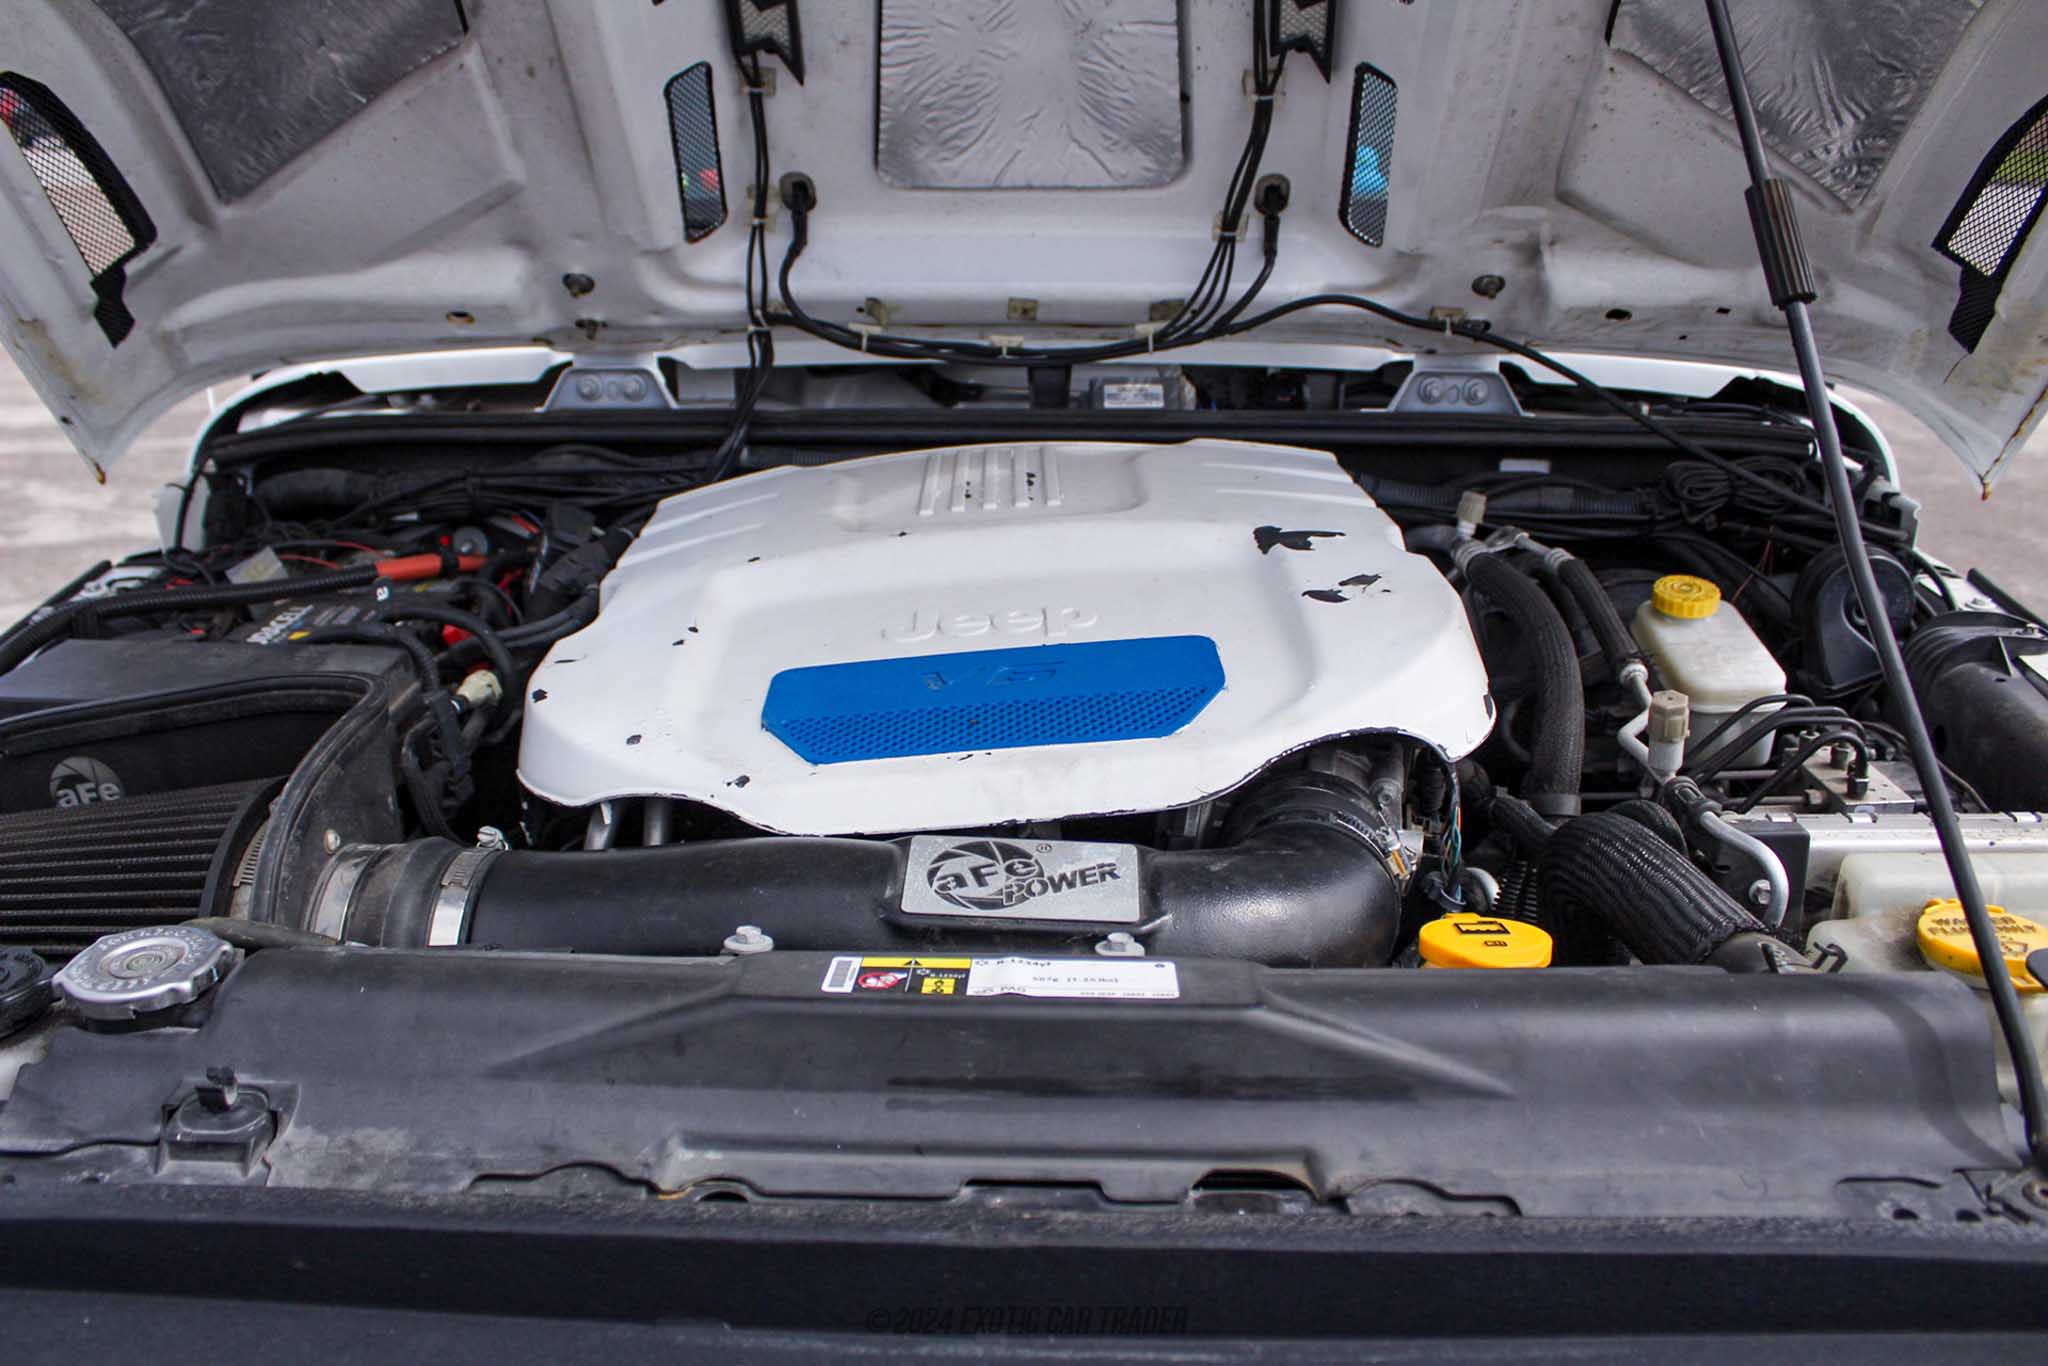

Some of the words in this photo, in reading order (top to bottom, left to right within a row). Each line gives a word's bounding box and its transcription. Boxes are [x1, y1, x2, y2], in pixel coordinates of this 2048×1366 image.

[880, 607, 1098, 643] Jeep
[56, 782, 121, 808] aFe
[934, 858, 1039, 893] aFe
[1002, 861, 1121, 906] POWER
